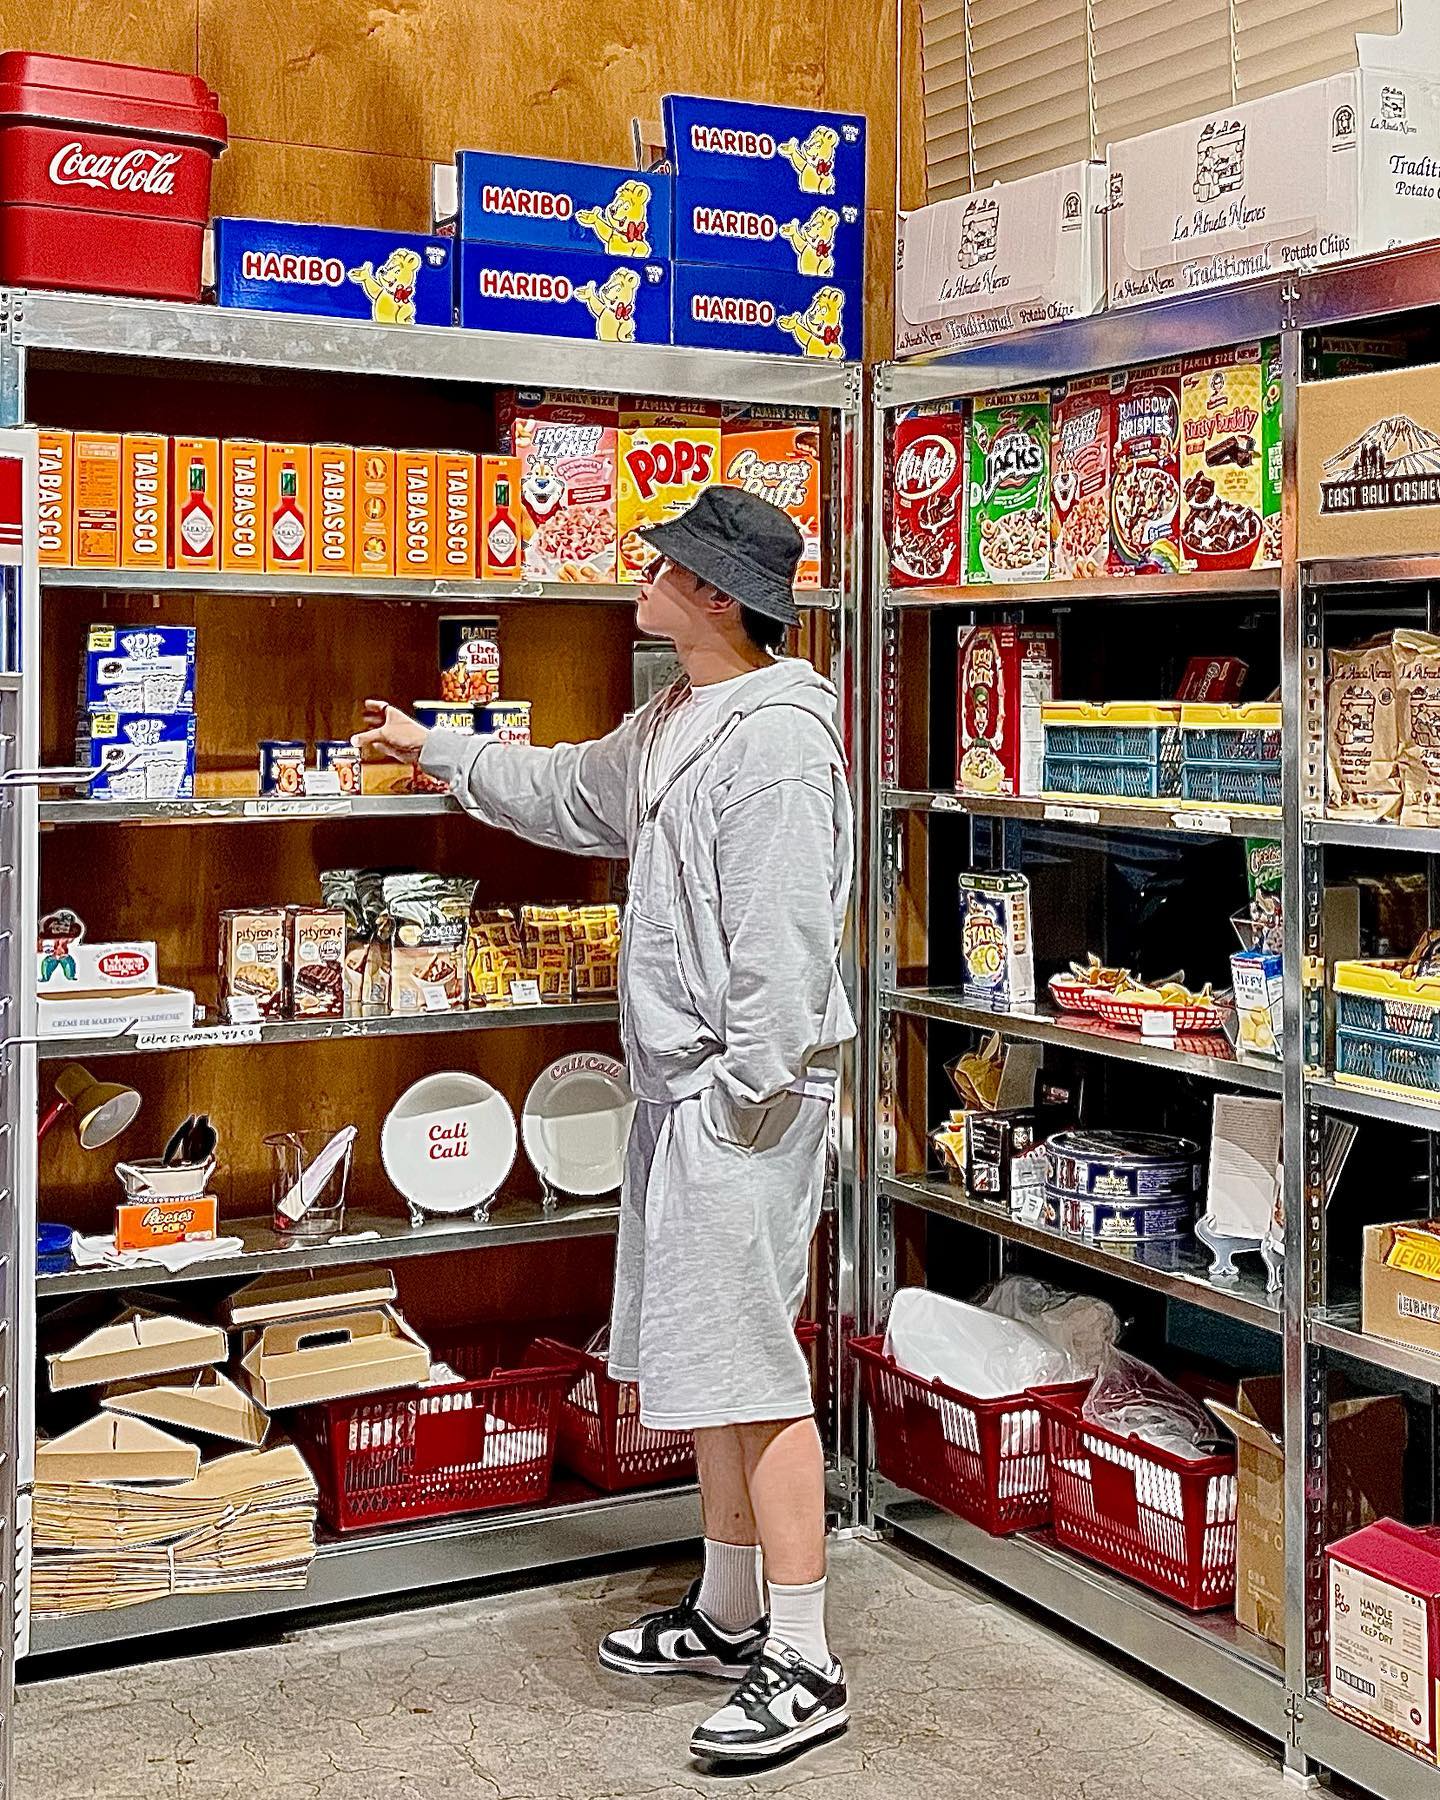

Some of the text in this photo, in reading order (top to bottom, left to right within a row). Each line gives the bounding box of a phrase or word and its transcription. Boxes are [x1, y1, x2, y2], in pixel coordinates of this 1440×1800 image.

[691, 125, 775, 159] HARIBO
[482, 185, 573, 220] HARIBO
[1396, 181, 1435, 198] Potato
[693, 207, 776, 241] HARIBO
[1172, 195, 1267, 242] La Abuela Nieves
[243, 251, 344, 287] HARIBO
[1182, 242, 1272, 288] Traditional
[1281, 243, 1317, 264] Potato
[1319, 233, 1351, 260] Chips
[480, 269, 570, 302] HARIBO
[693, 295, 775, 328] HARIBO
[945, 307, 1015, 341] Traditional
[1183, 357, 1212, 371] FAMILY
[1214, 351, 1233, 365] SIZE
[634, 399, 706, 414] FAMILY SIZE
[1118, 395, 1172, 421] RAINBOW
[533, 425, 603, 446] FROSTED
[1118, 414, 1172, 443] KRISPIES
[625, 439, 716, 500] POPS
[982, 446, 1042, 502] JACKS
[38, 446, 63, 550] TABASCO
[132, 451, 159, 554] TABASCO
[233, 456, 257, 558] TABASCO
[322, 460, 346, 561] TABASCO
[1328, 486, 1356, 508] EAST
[1361, 484, 1390, 505] BALI
[406, 465, 430, 564] TABASCO
[446, 468, 469, 565] TABASCO
[963, 926, 1004, 960] STARS
[1235, 970, 1263, 988] JIFFY
[91, 1016, 128, 1026] MARRONS
[551, 1055, 622, 1081] Cali Cali
[428, 1122, 469, 1142] Cali
[429, 1140, 469, 1160] Cali
[142, 1206, 195, 1228] Reese's
[1360, 1597, 1393, 1620] HANDLE
[1361, 1624, 1378, 1638] KEEP
